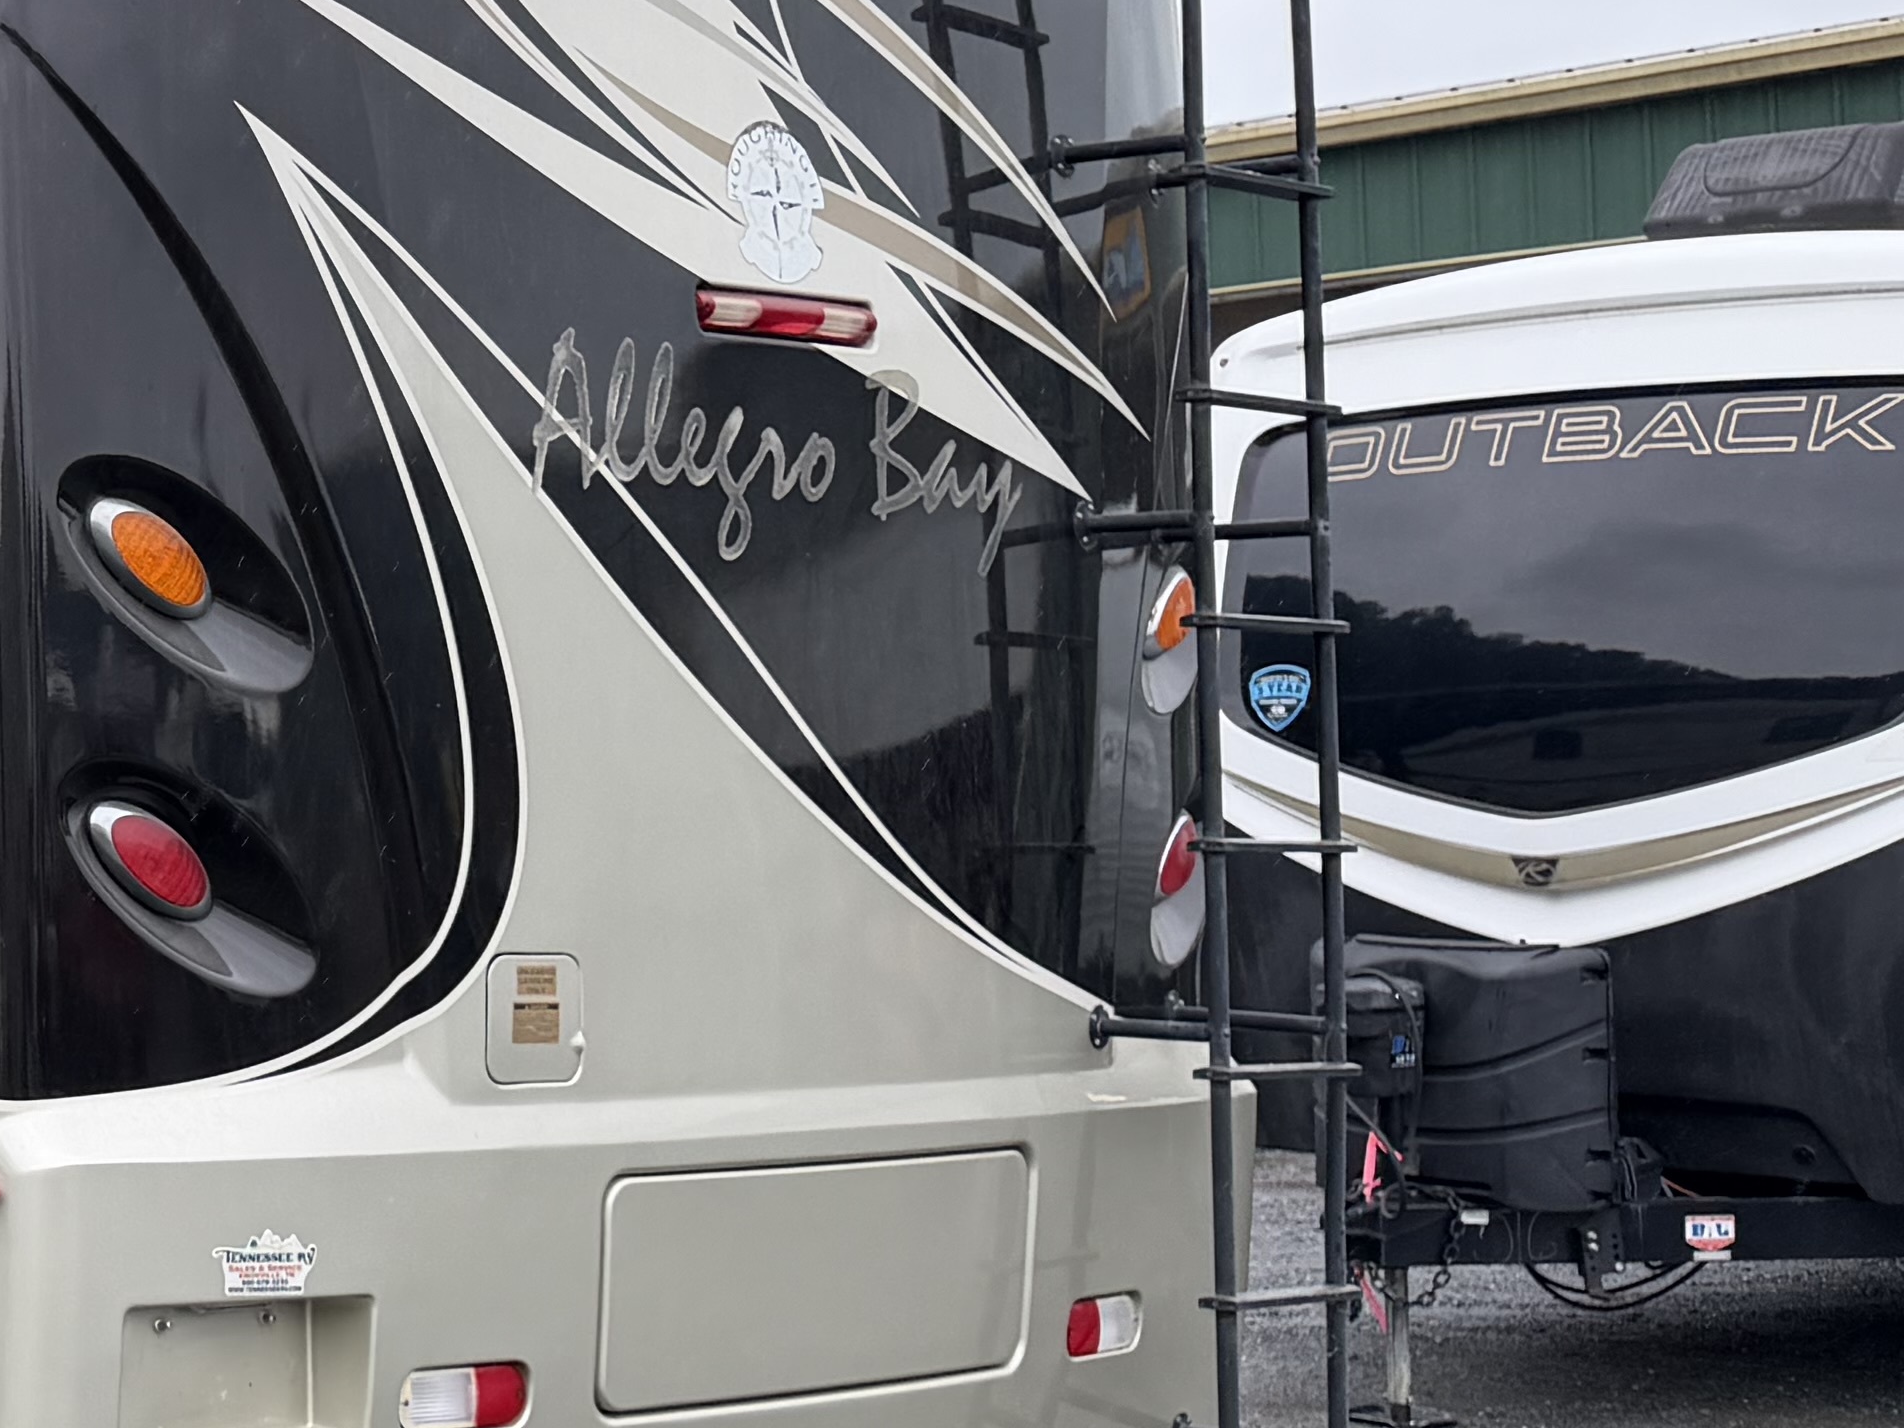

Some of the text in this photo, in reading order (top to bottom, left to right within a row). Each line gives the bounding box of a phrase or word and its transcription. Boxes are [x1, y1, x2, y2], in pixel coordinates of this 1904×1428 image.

[533, 327, 1023, 576] Allegro Bay
[1327, 394, 1904, 482] OUTBACK
[215, 1247, 315, 1265] TENNESSEE RV
